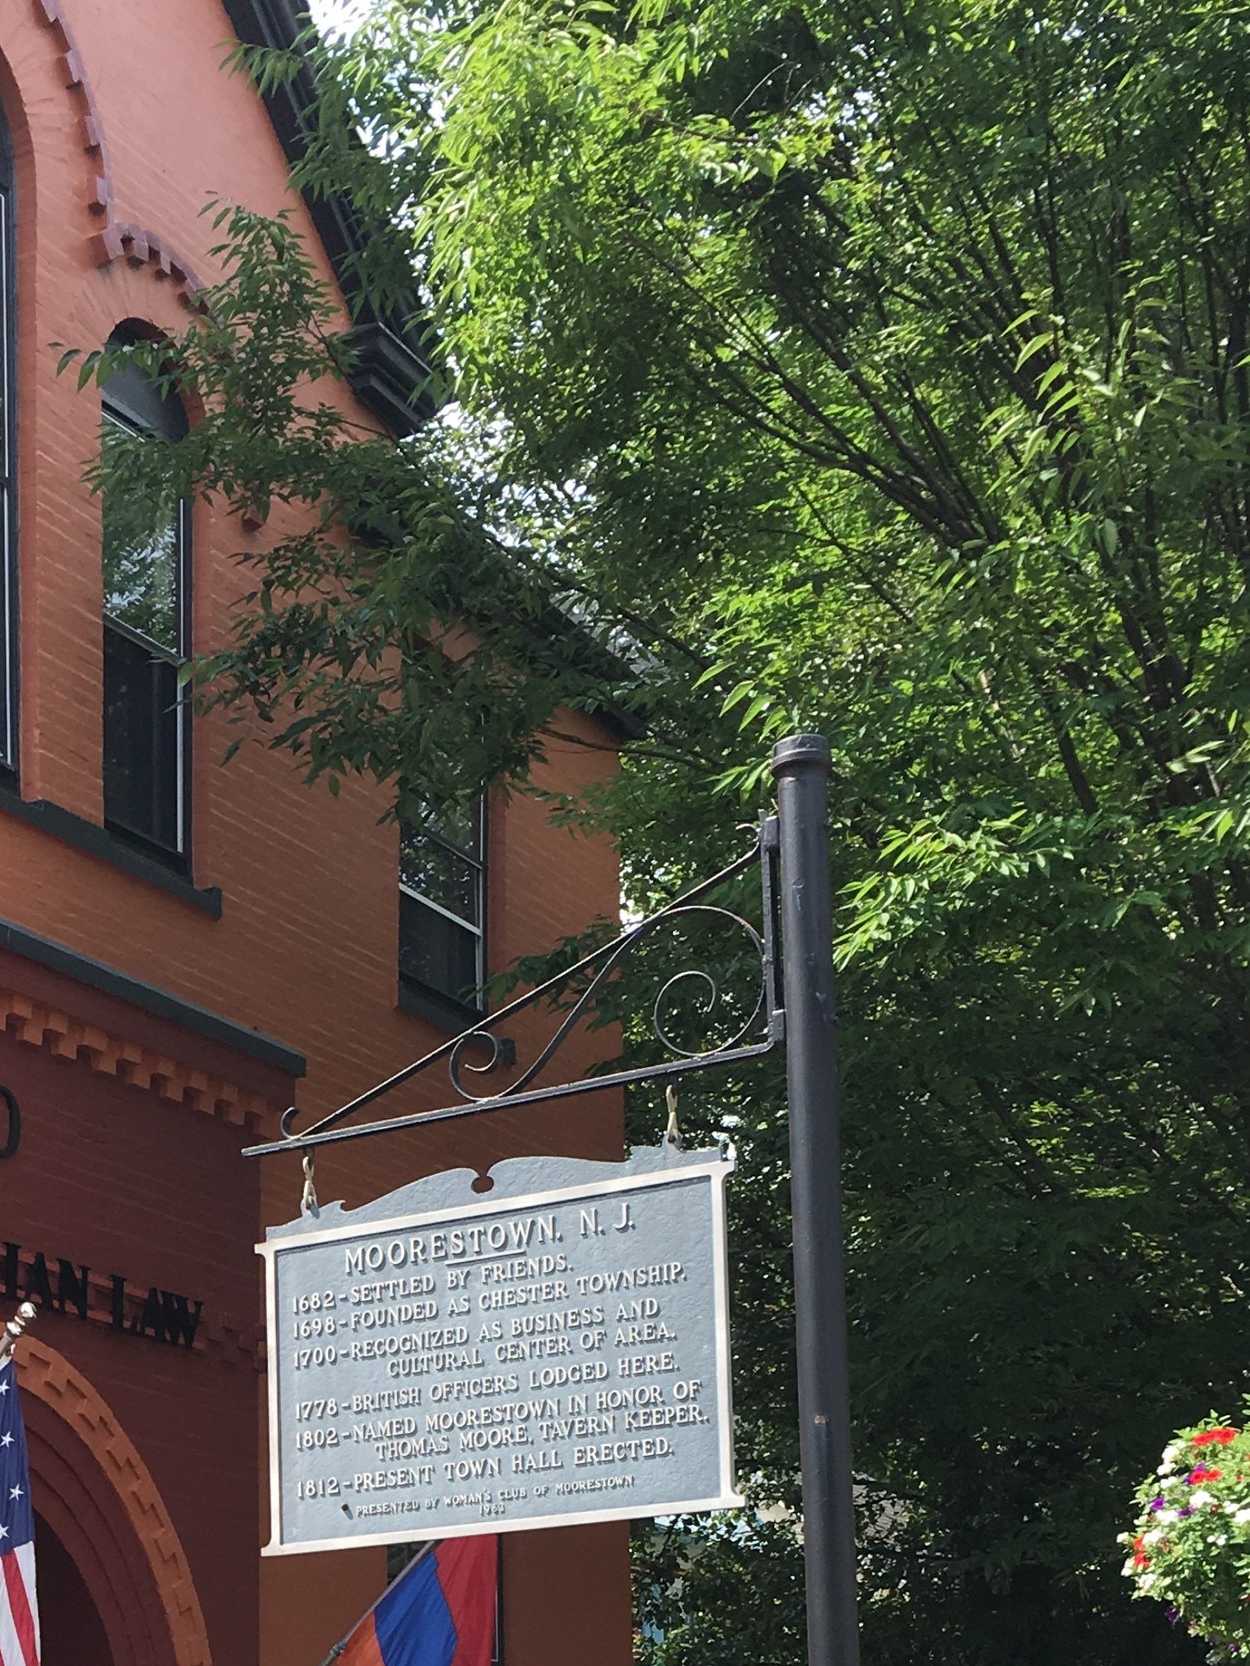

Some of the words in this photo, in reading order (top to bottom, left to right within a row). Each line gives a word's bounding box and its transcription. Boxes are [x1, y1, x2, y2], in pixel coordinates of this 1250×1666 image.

[447, 1269, 471, 1288] BY
[482, 1253, 573, 1283] FRIENDS.
[448, 1297, 471, 1314] AS
[479, 1280, 569, 1310] CHESTER
[576, 1261, 687, 1295] TOWNSHIP.
[109, 1273, 206, 1349] LAW
[480, 1322, 503, 1341] AS
[511, 1306, 605, 1336] BUSINESS
[616, 1298, 660, 1321] AND
[388, 1348, 484, 1377] CULTURAL
[495, 1334, 571, 1361] CENTER
[580, 1329, 607, 1350] OF
[614, 1322, 677, 1345] AREA.
[430, 1374, 519, 1402] OFFICERS
[529, 1361, 608, 1389] LODGED
[618, 1352, 680, 1375] HERE.
[426, 1400, 561, 1431] MOORESTOWN
[568, 1394, 589, 1414] IN
[595, 1385, 663, 1410] HONOR
[673, 1379, 703, 1400] OF
[375, 1436, 450, 1461] THOMAS
[539, 1414, 615, 1440] TAVERN
[625, 1404, 709, 1430] KEEPER.
[444, 1458, 501, 1480] TOWN
[512, 1450, 563, 1473] HALL
[573, 1437, 675, 1465] ERECTED.
[356, 1500, 420, 1517] PRESENTED
[425, 1498, 439, 1509] BY
[443, 1490, 492, 1506] WOMAN'S
[499, 1487, 527, 1500] CLUB
[533, 1484, 549, 1496] OF
[556, 1475, 635, 1494] MOORESTOWN
